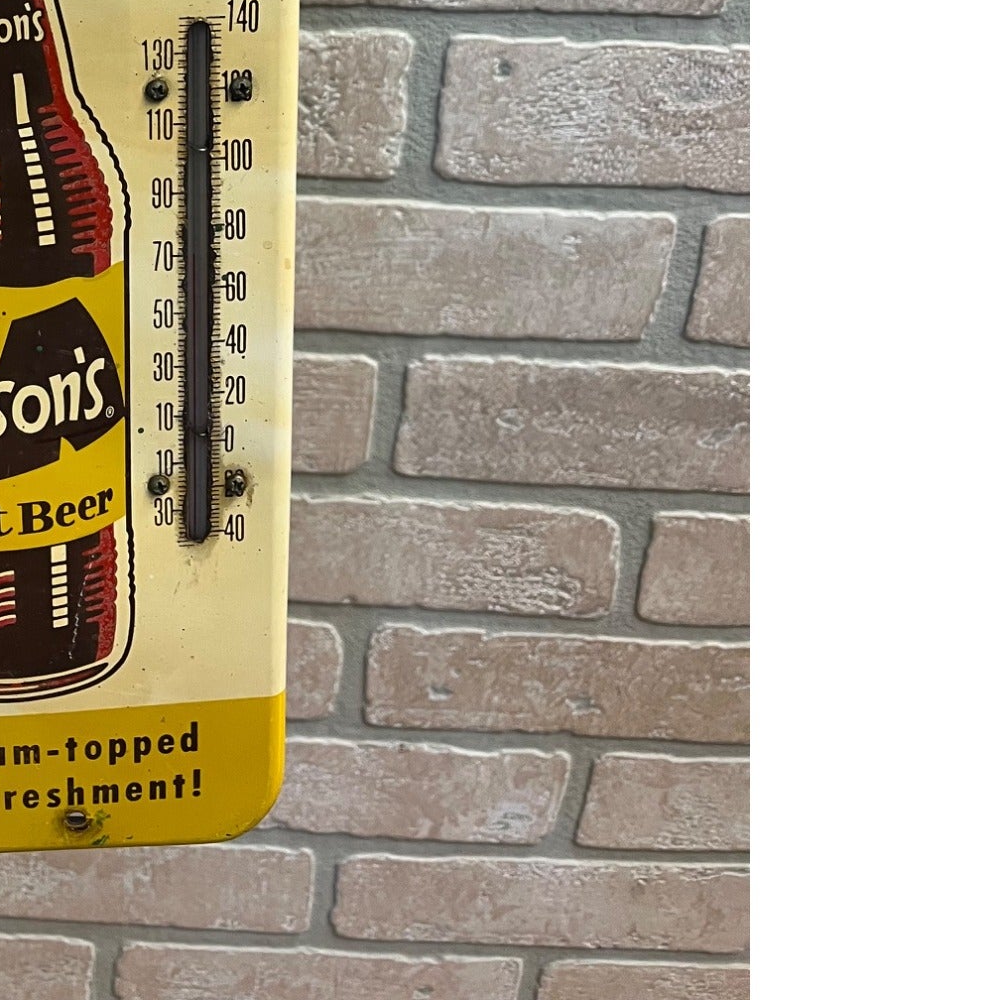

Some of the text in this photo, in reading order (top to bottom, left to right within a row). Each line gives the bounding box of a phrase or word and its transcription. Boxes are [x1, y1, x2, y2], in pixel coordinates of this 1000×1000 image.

[227, 0, 260, 32] 140
[141, 38, 174, 71] 130
[146, 109, 173, 140] 110
[221, 139, 253, 171] 100
[151, 177, 173, 209] 90
[225, 208, 246, 240] 80
[152, 240, 173, 271] 70
[225, 271, 247, 301] 60
[153, 299, 173, 329] 50
[225, 324, 247, 354] 40
[153, 352, 173, 382] 30
[224, 375, 246, 405] 20
[155, 402, 173, 431] 10
[224, 424, 234, 452] 0
[156, 449, 173, 477] 10
[17, 487, 114, 536] Beer
[154, 497, 173, 526] 30
[225, 514, 245, 542] 40
